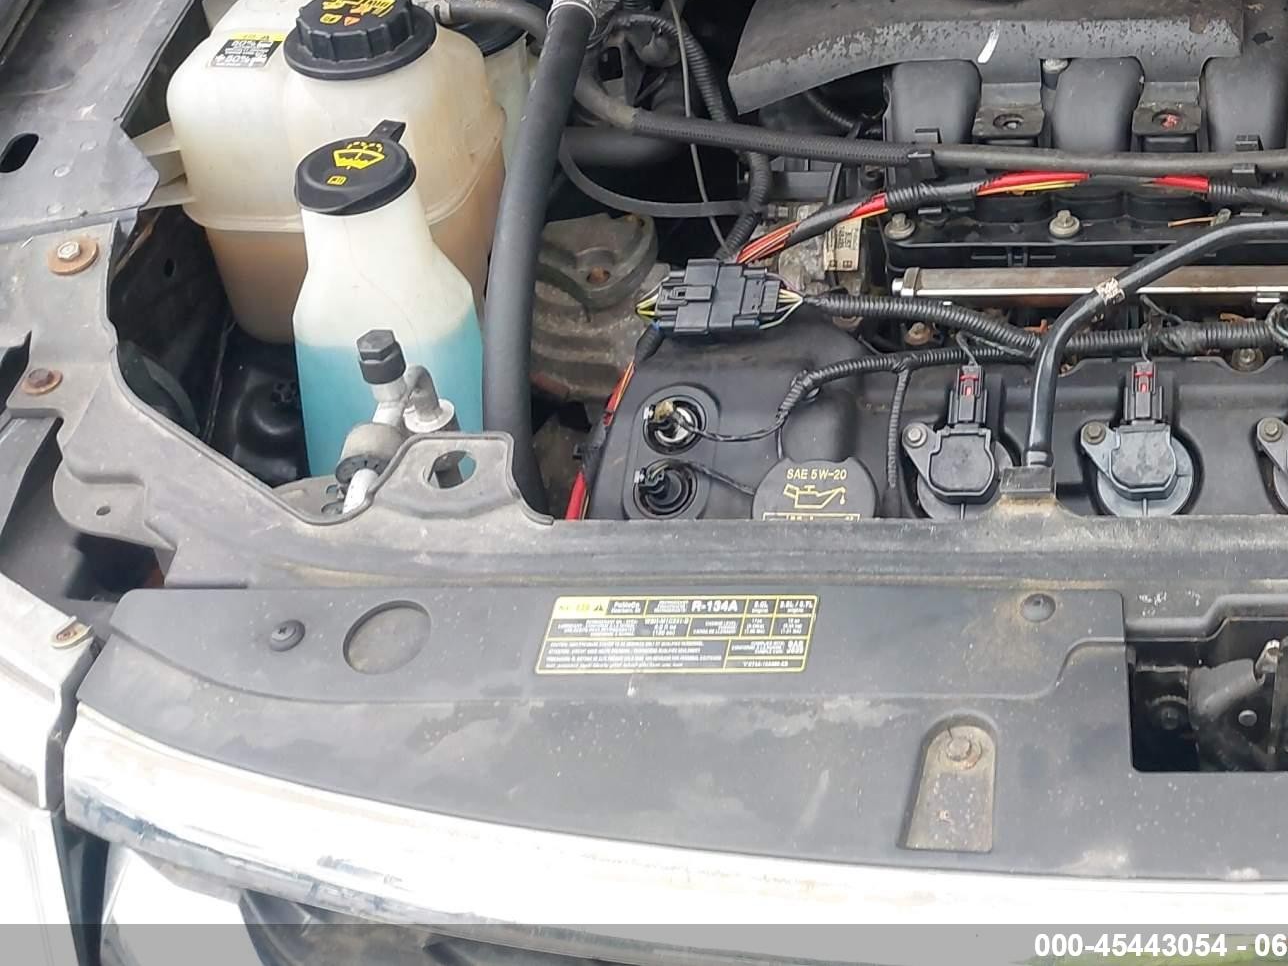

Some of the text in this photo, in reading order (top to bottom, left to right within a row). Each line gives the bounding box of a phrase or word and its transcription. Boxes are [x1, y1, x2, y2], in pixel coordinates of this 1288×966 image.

[786, 468, 848, 480] SAE 5W-20
[690, 599, 739, 613] R-134A
